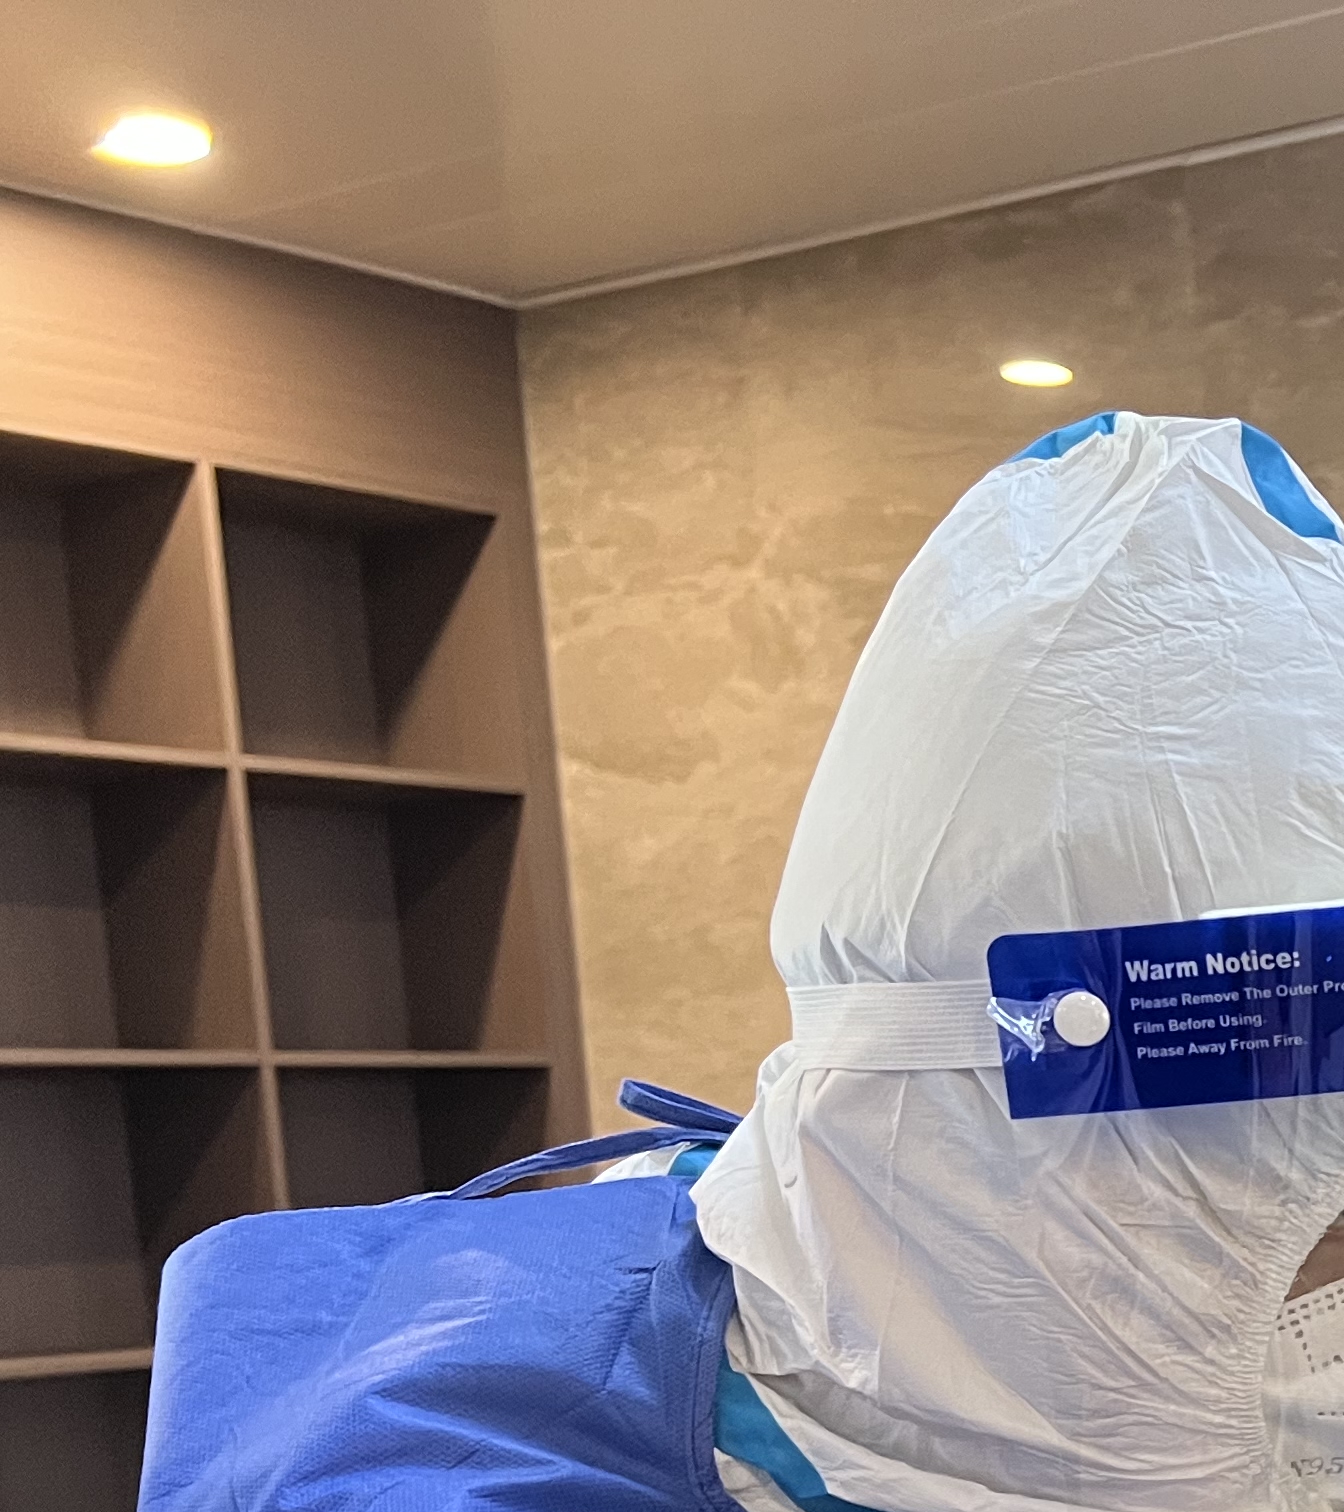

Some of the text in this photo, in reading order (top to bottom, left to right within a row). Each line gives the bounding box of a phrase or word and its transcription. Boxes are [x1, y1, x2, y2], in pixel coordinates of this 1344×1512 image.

[1125, 949, 1300, 983] Warm Notice:
[1130, 995, 1178, 1011] Please
[1181, 990, 1240, 1006] Remove
[1244, 986, 1272, 1000] The
[1275, 982, 1319, 998] Outer
[1133, 1020, 1165, 1035] Film
[1168, 1016, 1216, 1032] Before
[1136, 1033, 1309, 1060] Please Away From Fire.
